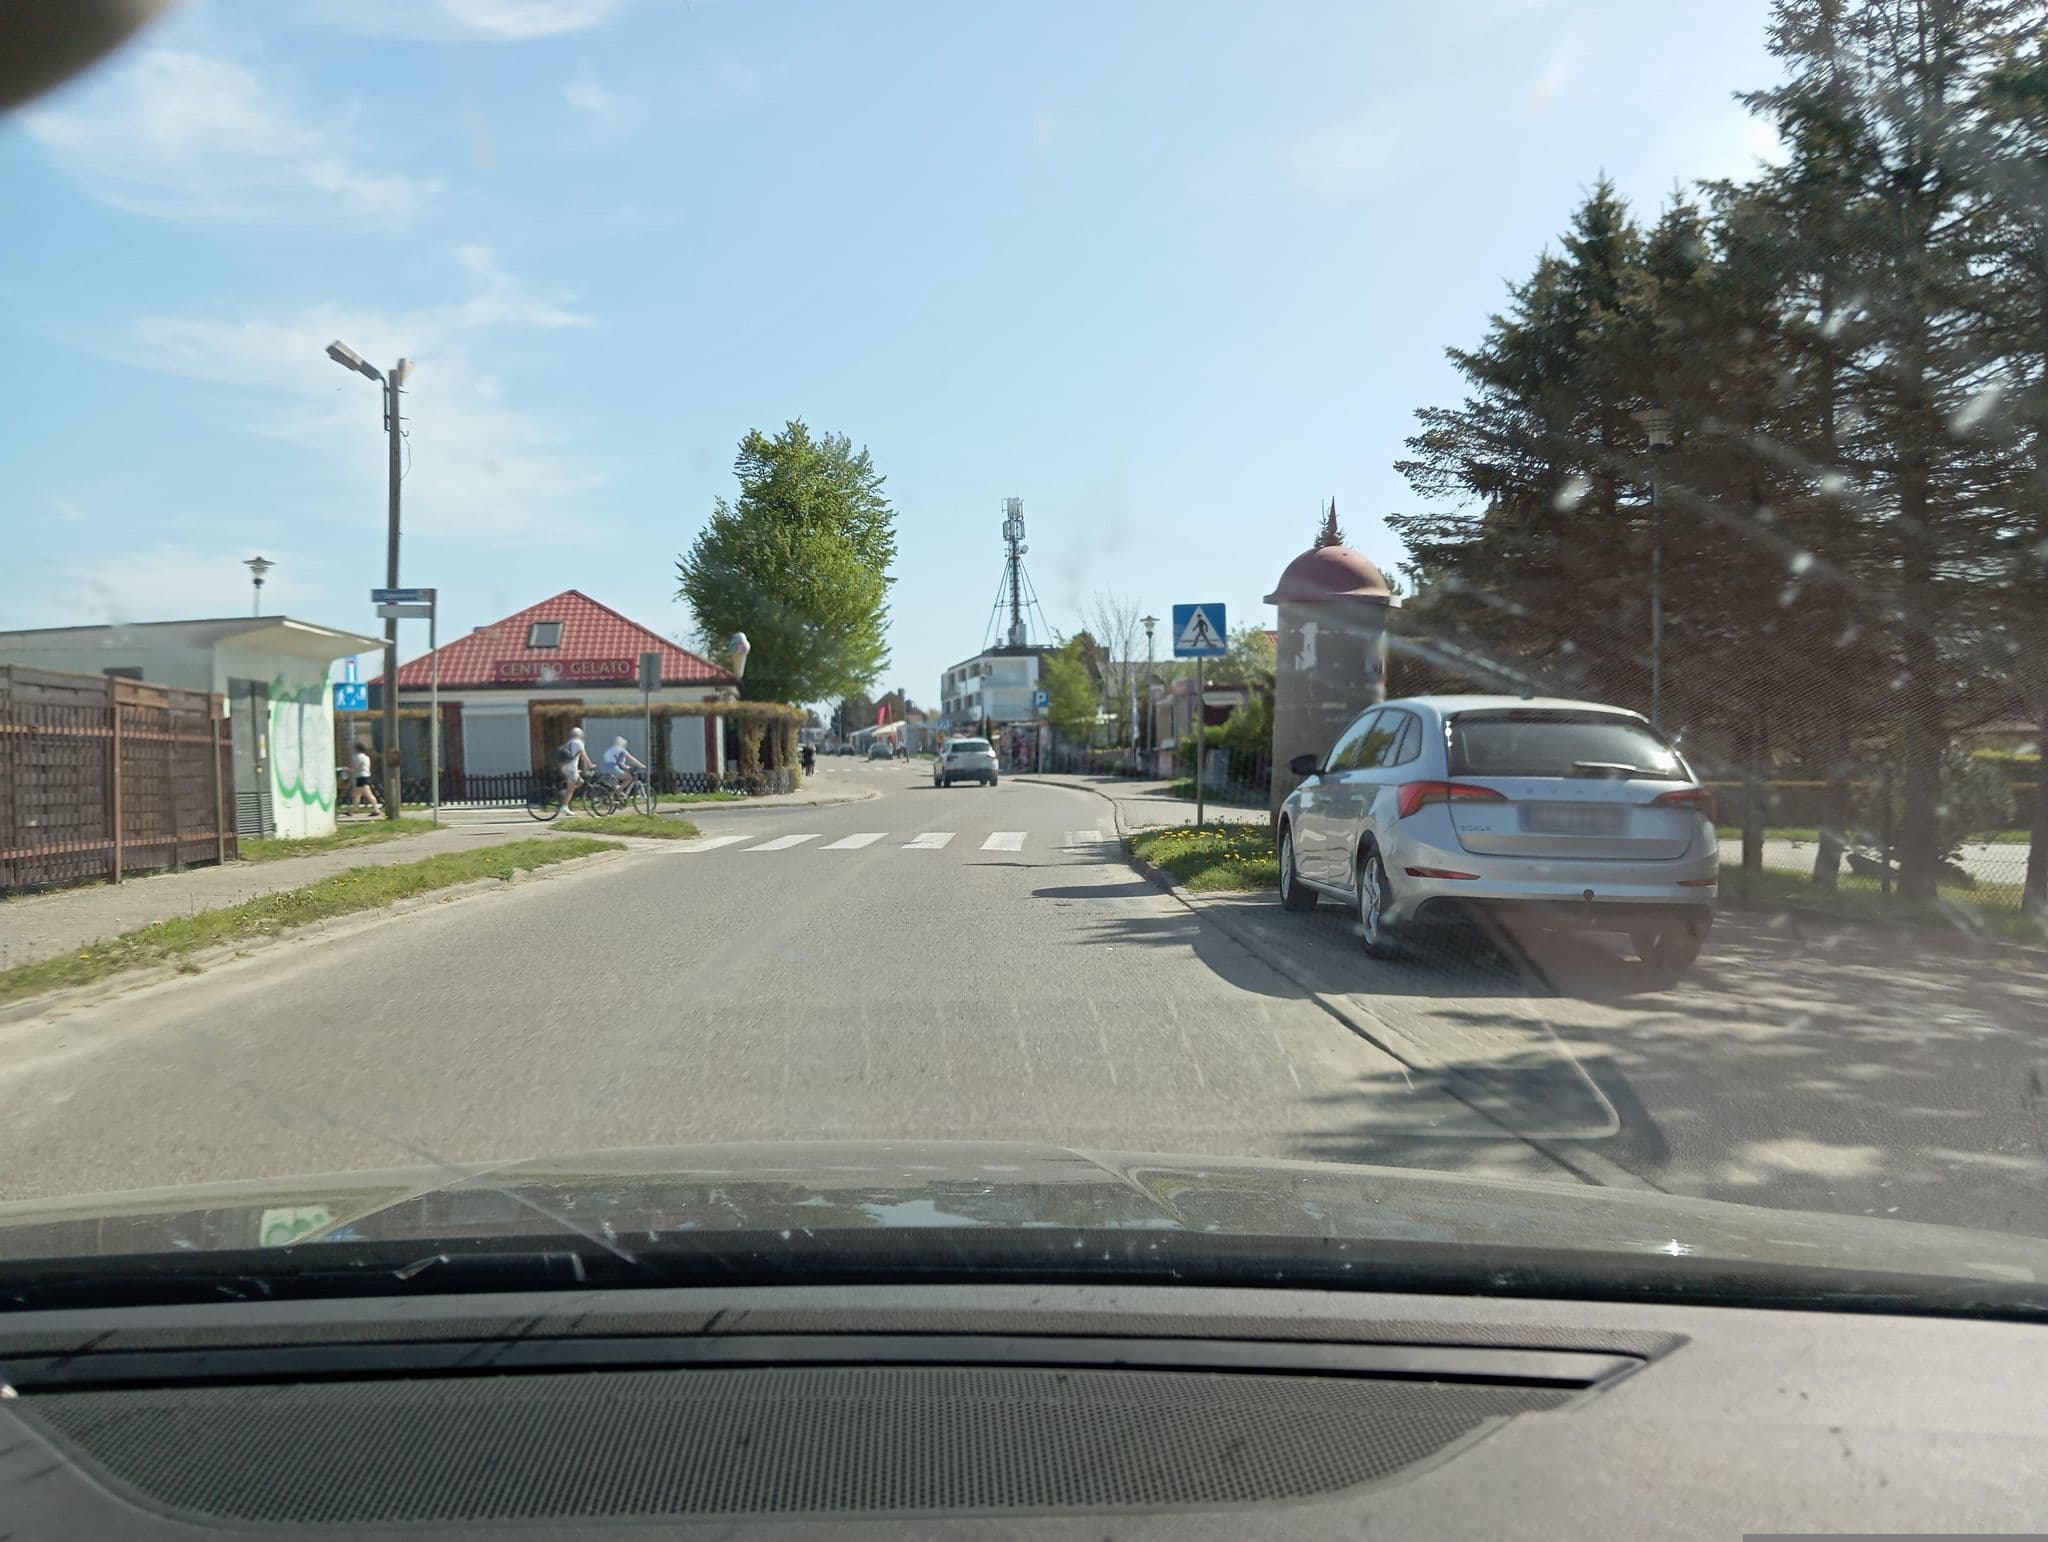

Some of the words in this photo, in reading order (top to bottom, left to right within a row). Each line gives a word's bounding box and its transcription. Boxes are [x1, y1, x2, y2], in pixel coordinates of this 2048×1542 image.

[500, 661, 563, 676] CENTRO
[570, 660, 630, 674] GELATO
[1035, 690, 1047, 706] P
